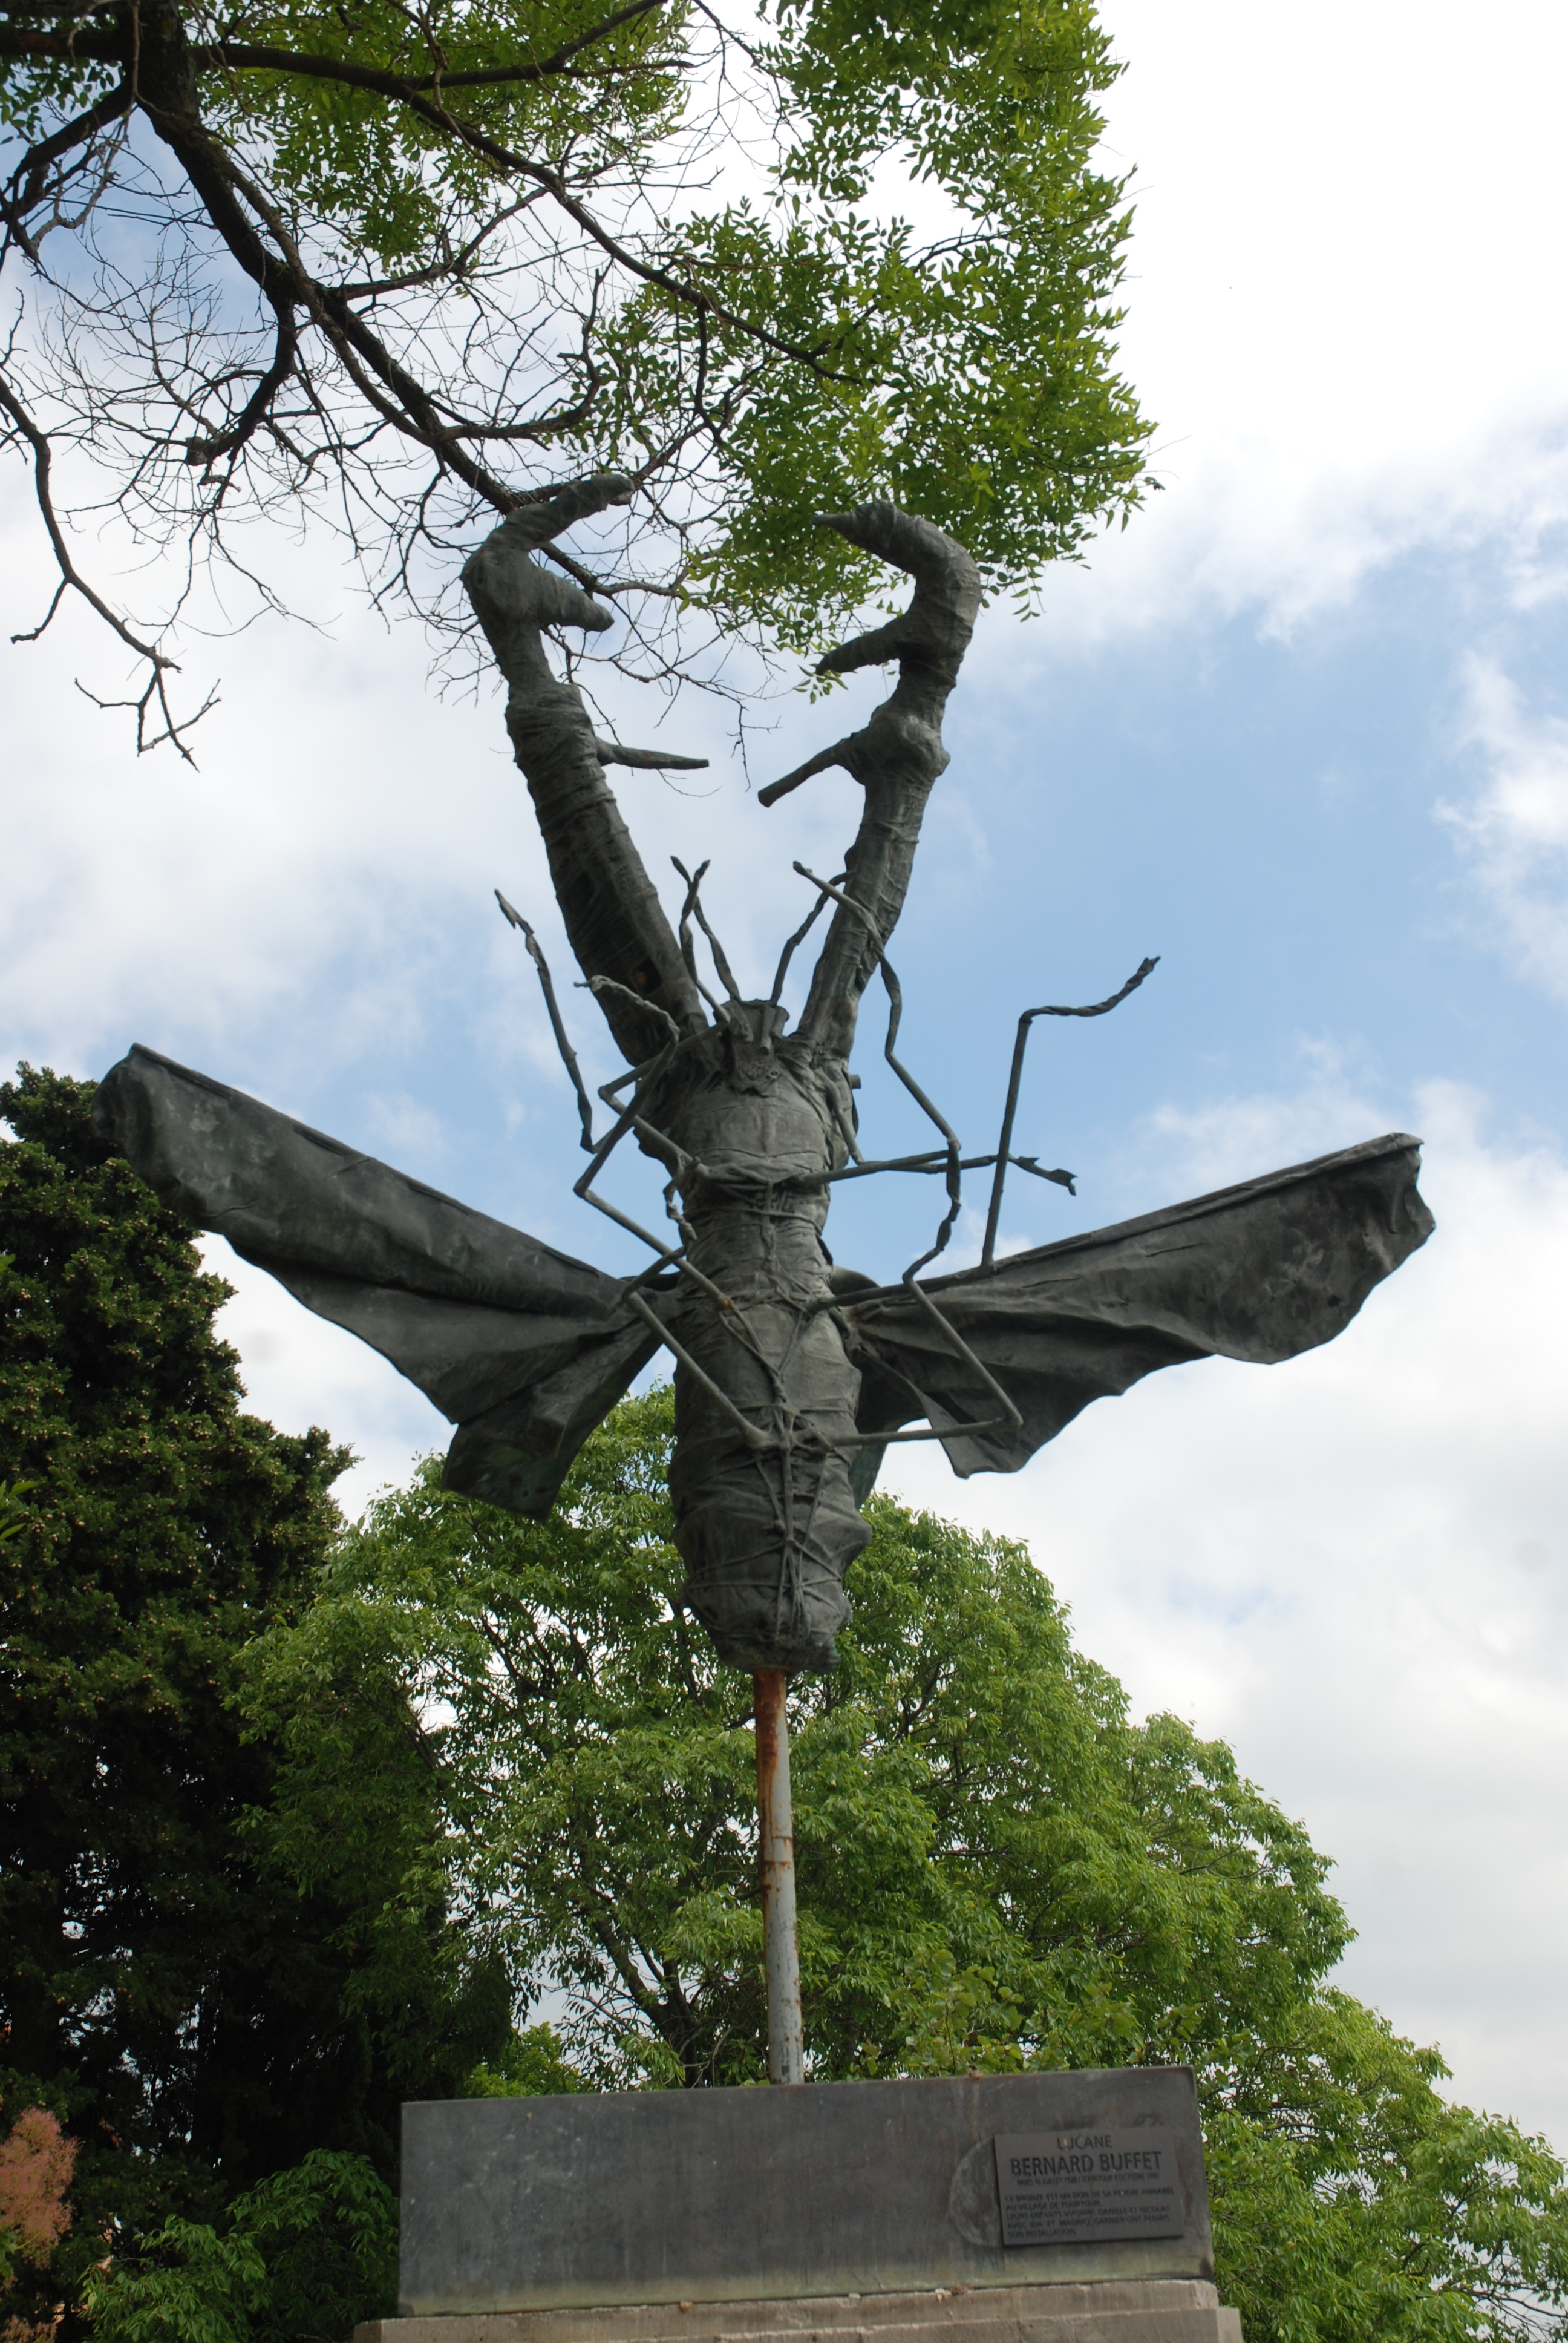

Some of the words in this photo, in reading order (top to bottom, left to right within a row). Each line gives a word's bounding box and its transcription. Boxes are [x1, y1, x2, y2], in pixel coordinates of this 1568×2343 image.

[1057, 2135, 1112, 2150] LUCANE
[1010, 2154, 1094, 2177] BERNARD
[1099, 2151, 1161, 2172] BUFFET
[1016, 2194, 1043, 2202] BRONZE
[1113, 2188, 1138, 2197] FEMME
[1142, 2187, 1175, 2195] ANNABEL
[1018, 2202, 1047, 2210] VILLAGE
[1140, 2204, 1171, 2214] NICOLAS
[1059, 2218, 1091, 2227] MAURICE
